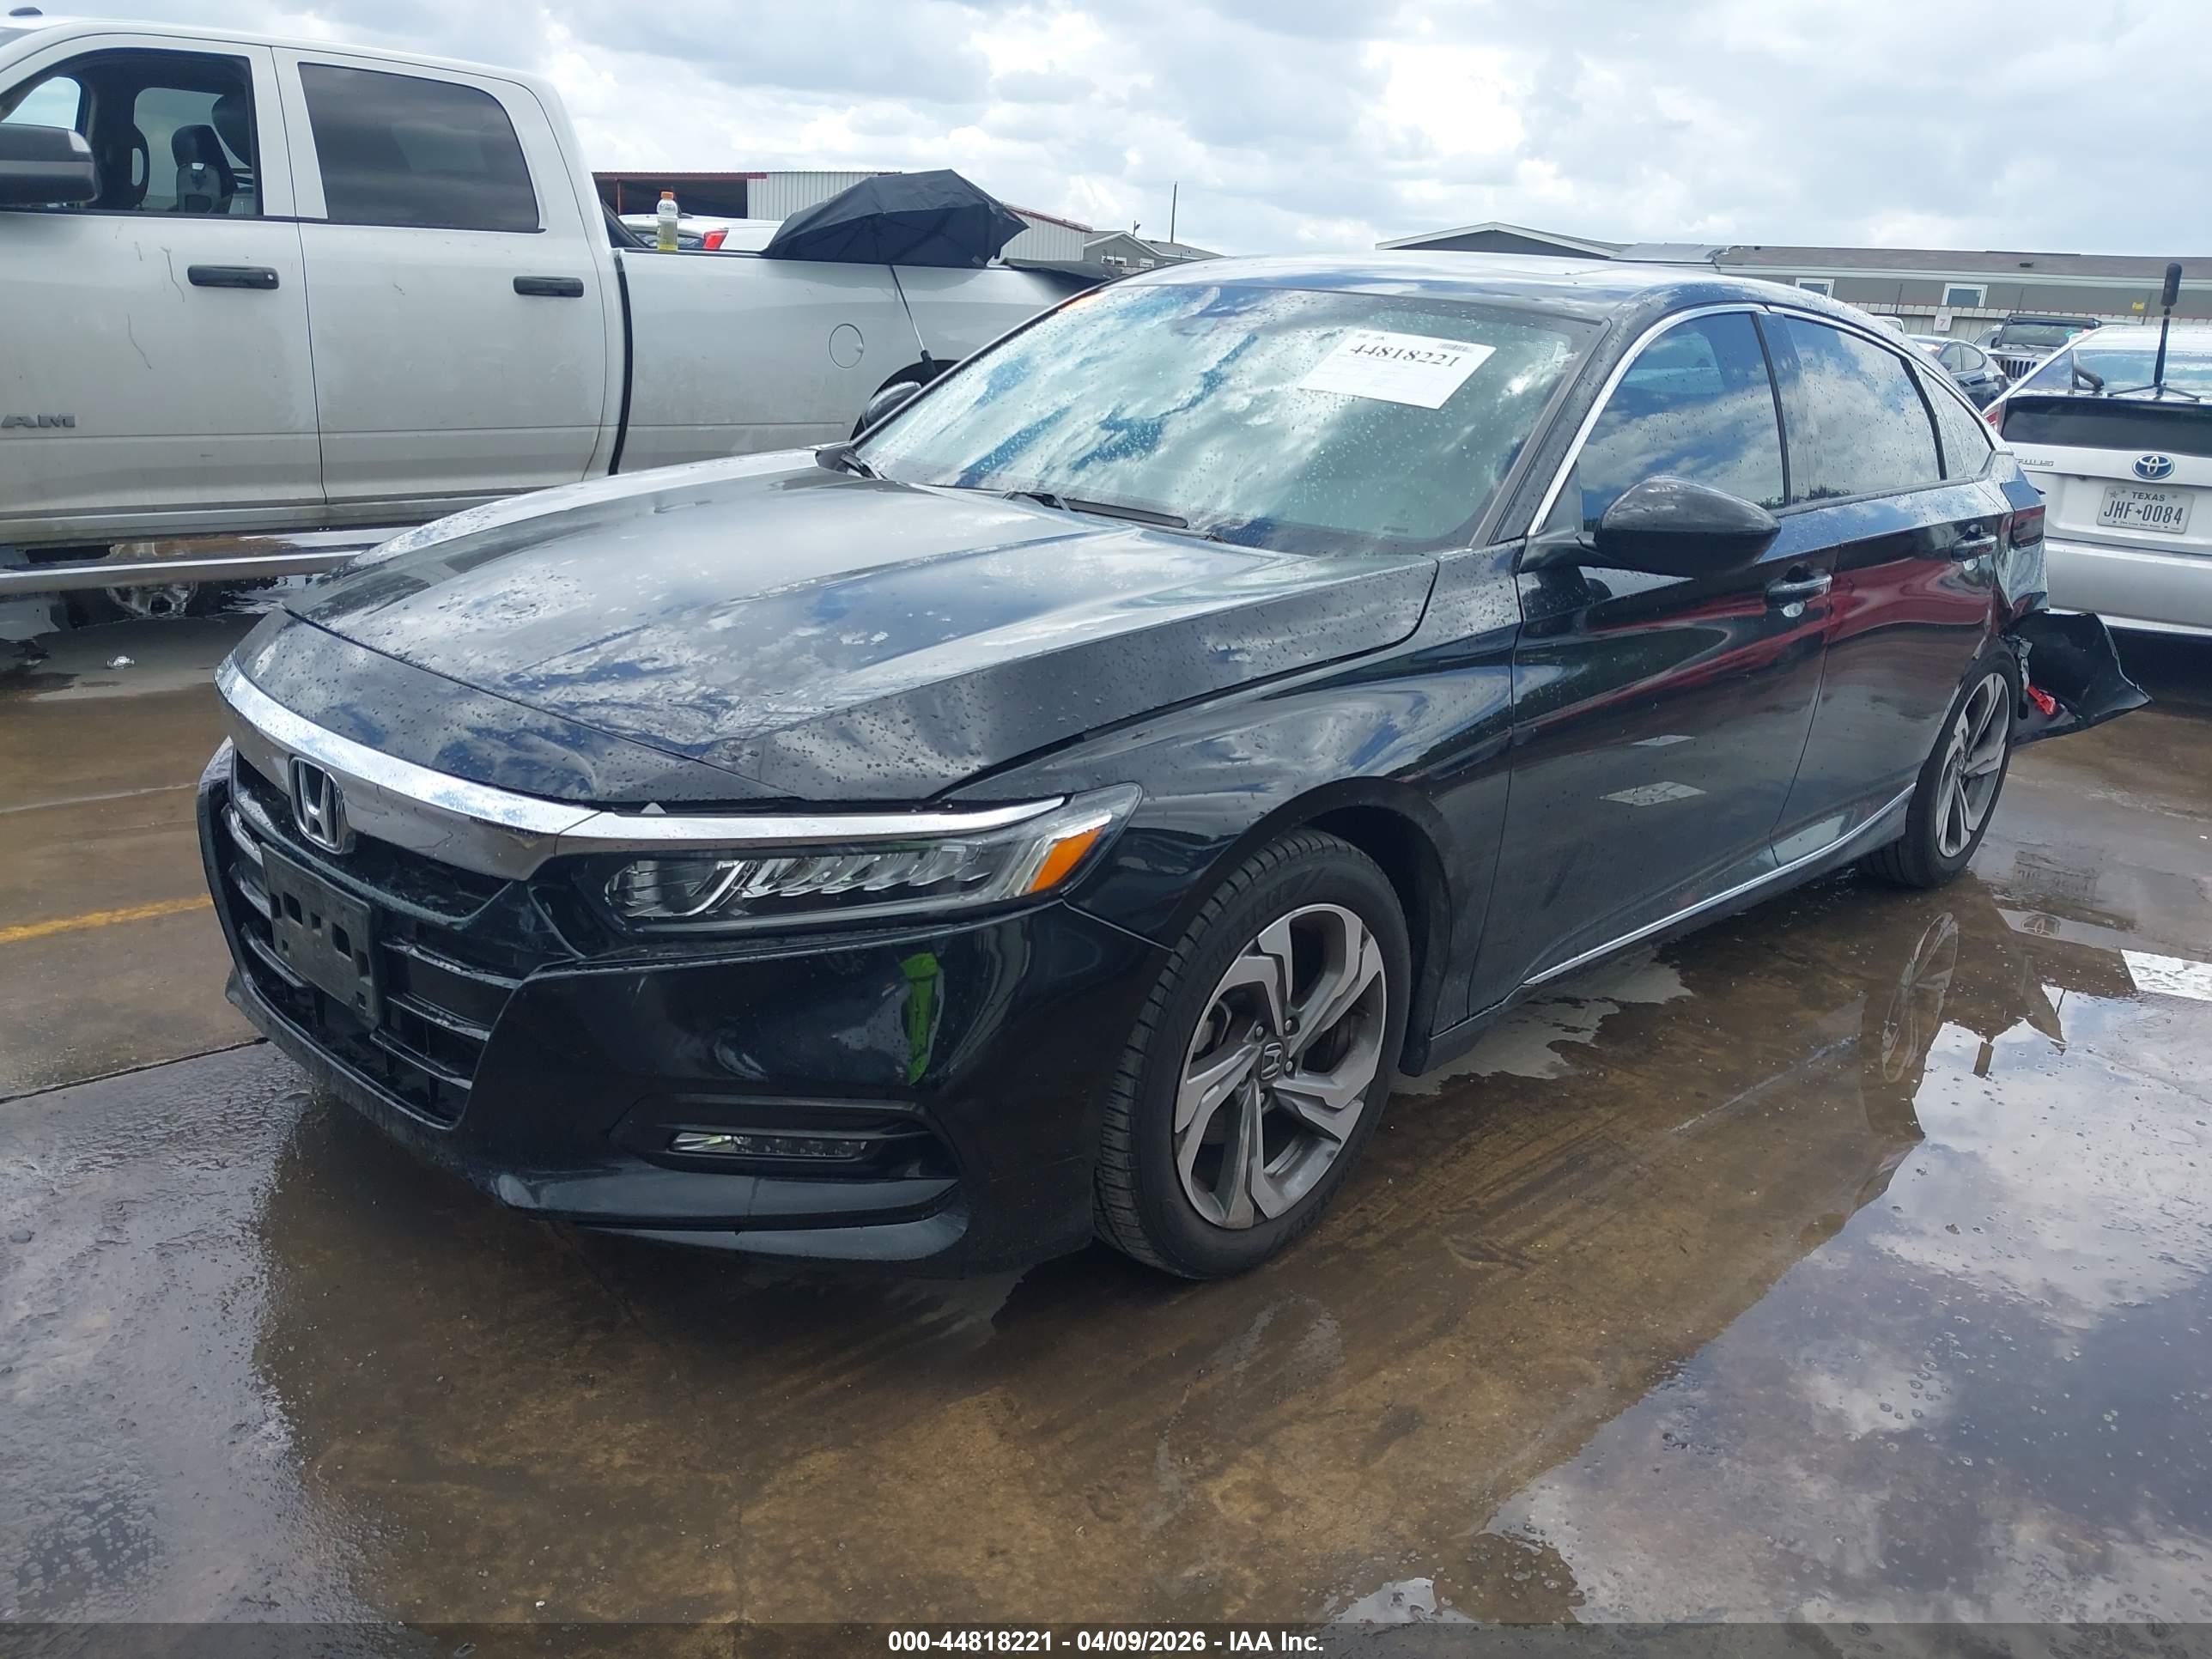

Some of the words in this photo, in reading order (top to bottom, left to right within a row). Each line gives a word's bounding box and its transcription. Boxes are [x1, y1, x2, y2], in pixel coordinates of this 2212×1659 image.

[1939, 319, 1947, 327] 7
[1350, 343, 1461, 367] 44818221
[0, 412, 76, 428] AM
[2131, 491, 2166, 502] TEXAS
